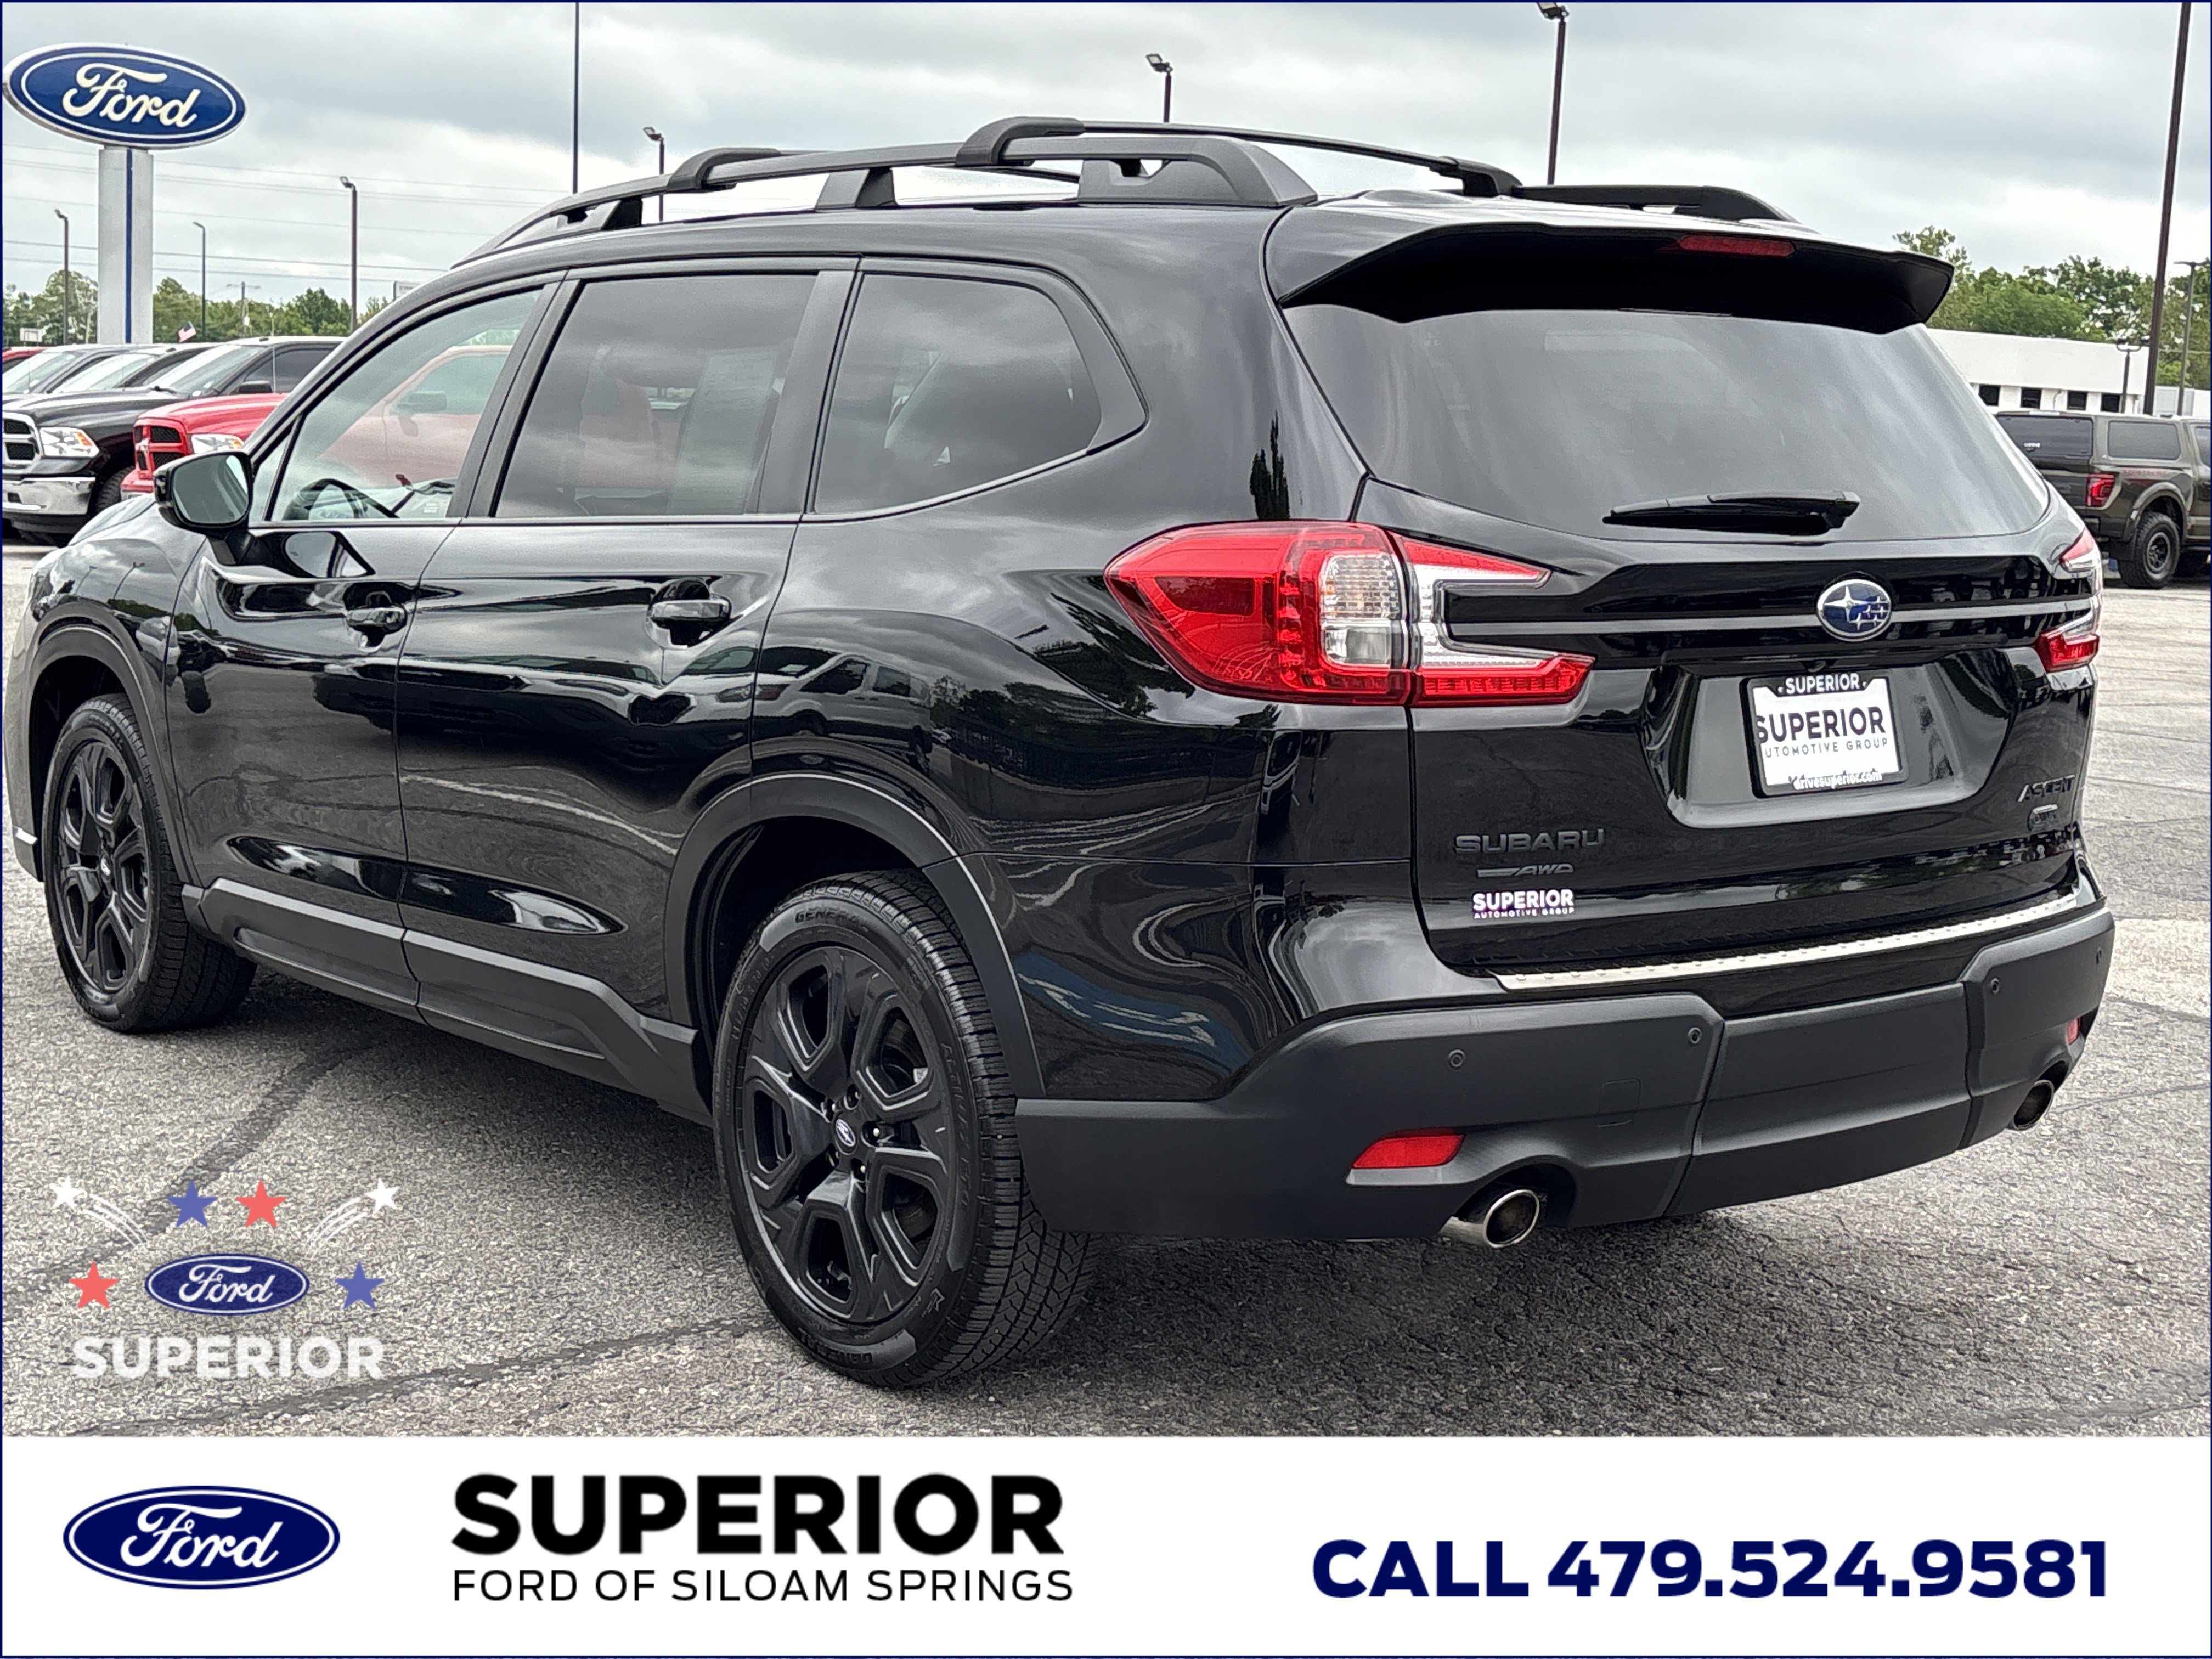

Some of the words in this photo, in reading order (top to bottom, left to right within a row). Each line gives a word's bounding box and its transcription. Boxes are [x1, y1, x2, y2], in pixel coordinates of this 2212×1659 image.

[62, 63, 201, 128] Ford
[1785, 673, 1860, 694] SUPERIOR
[1756, 706, 1886, 744] SUPERIOR
[1764, 742, 1838, 758] UTOMOTIVE
[1846, 737, 1888, 751] GROUP
[1455, 828, 1605, 854] SUBARU
[1514, 863, 1575, 877] AWD
[1472, 889, 1575, 911] SUPERIOR
[1474, 909, 1537, 919] AUTOMOTIVE
[1542, 907, 1575, 916] GROUP
